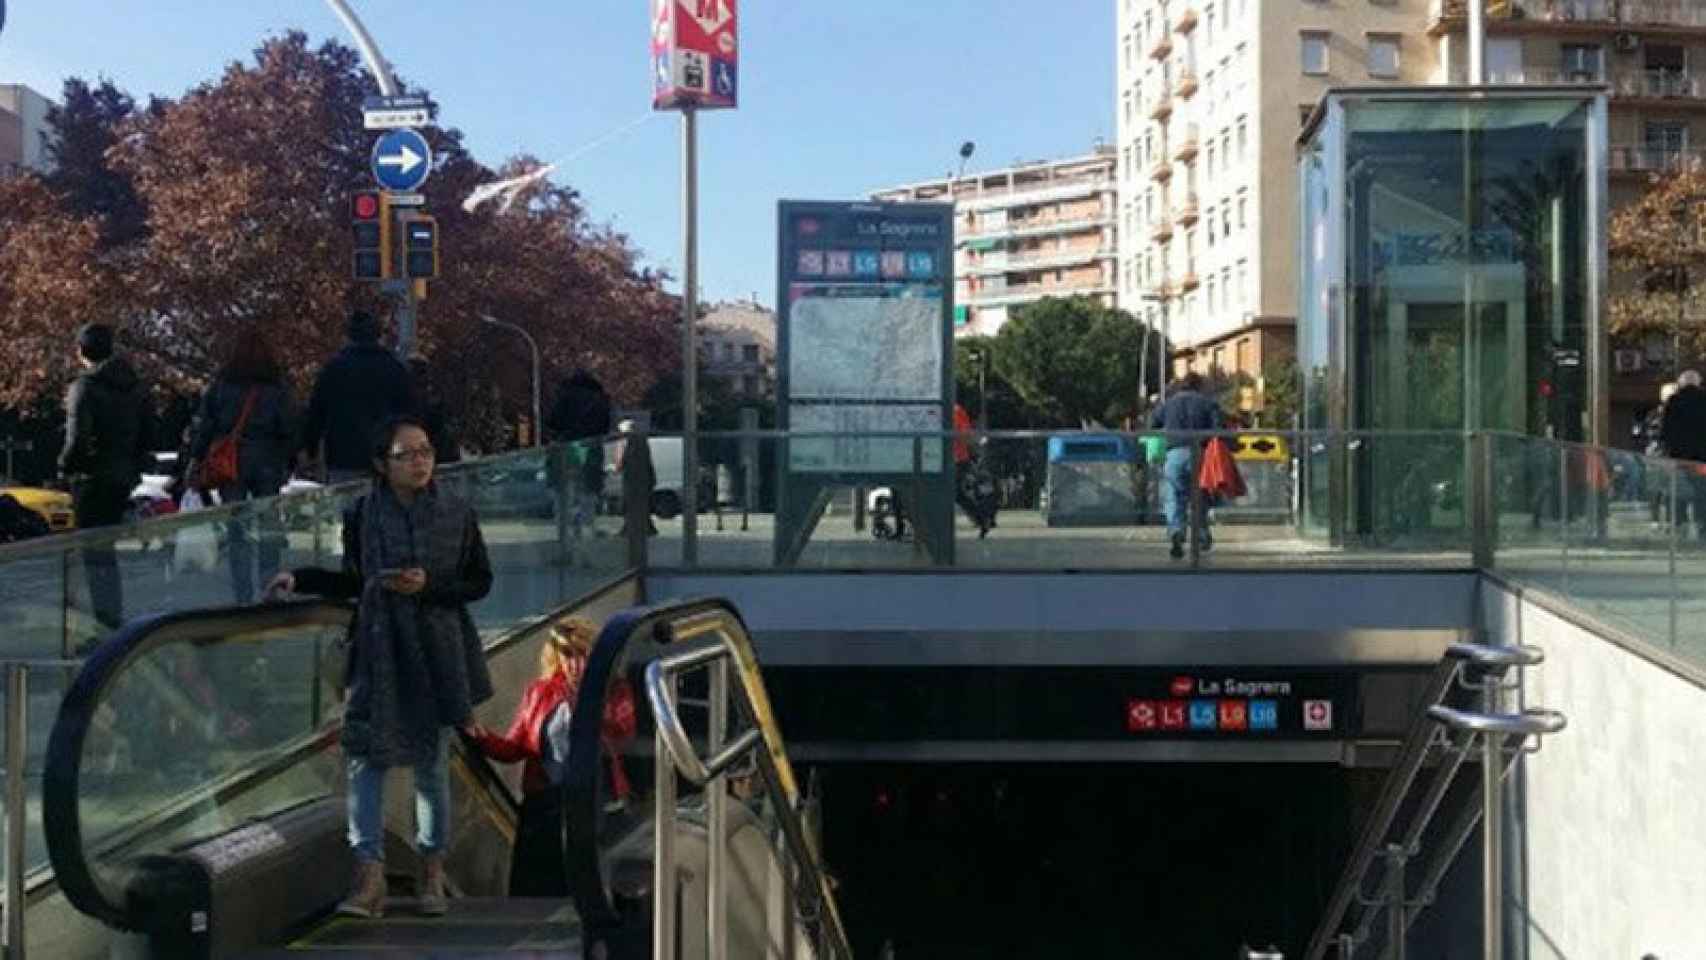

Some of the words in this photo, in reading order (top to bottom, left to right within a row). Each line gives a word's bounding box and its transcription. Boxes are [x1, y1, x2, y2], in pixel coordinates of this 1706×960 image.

[1198, 678, 1219, 693] La
[1224, 678, 1290, 696] Sagrera
[1164, 703, 1184, 725] L1
